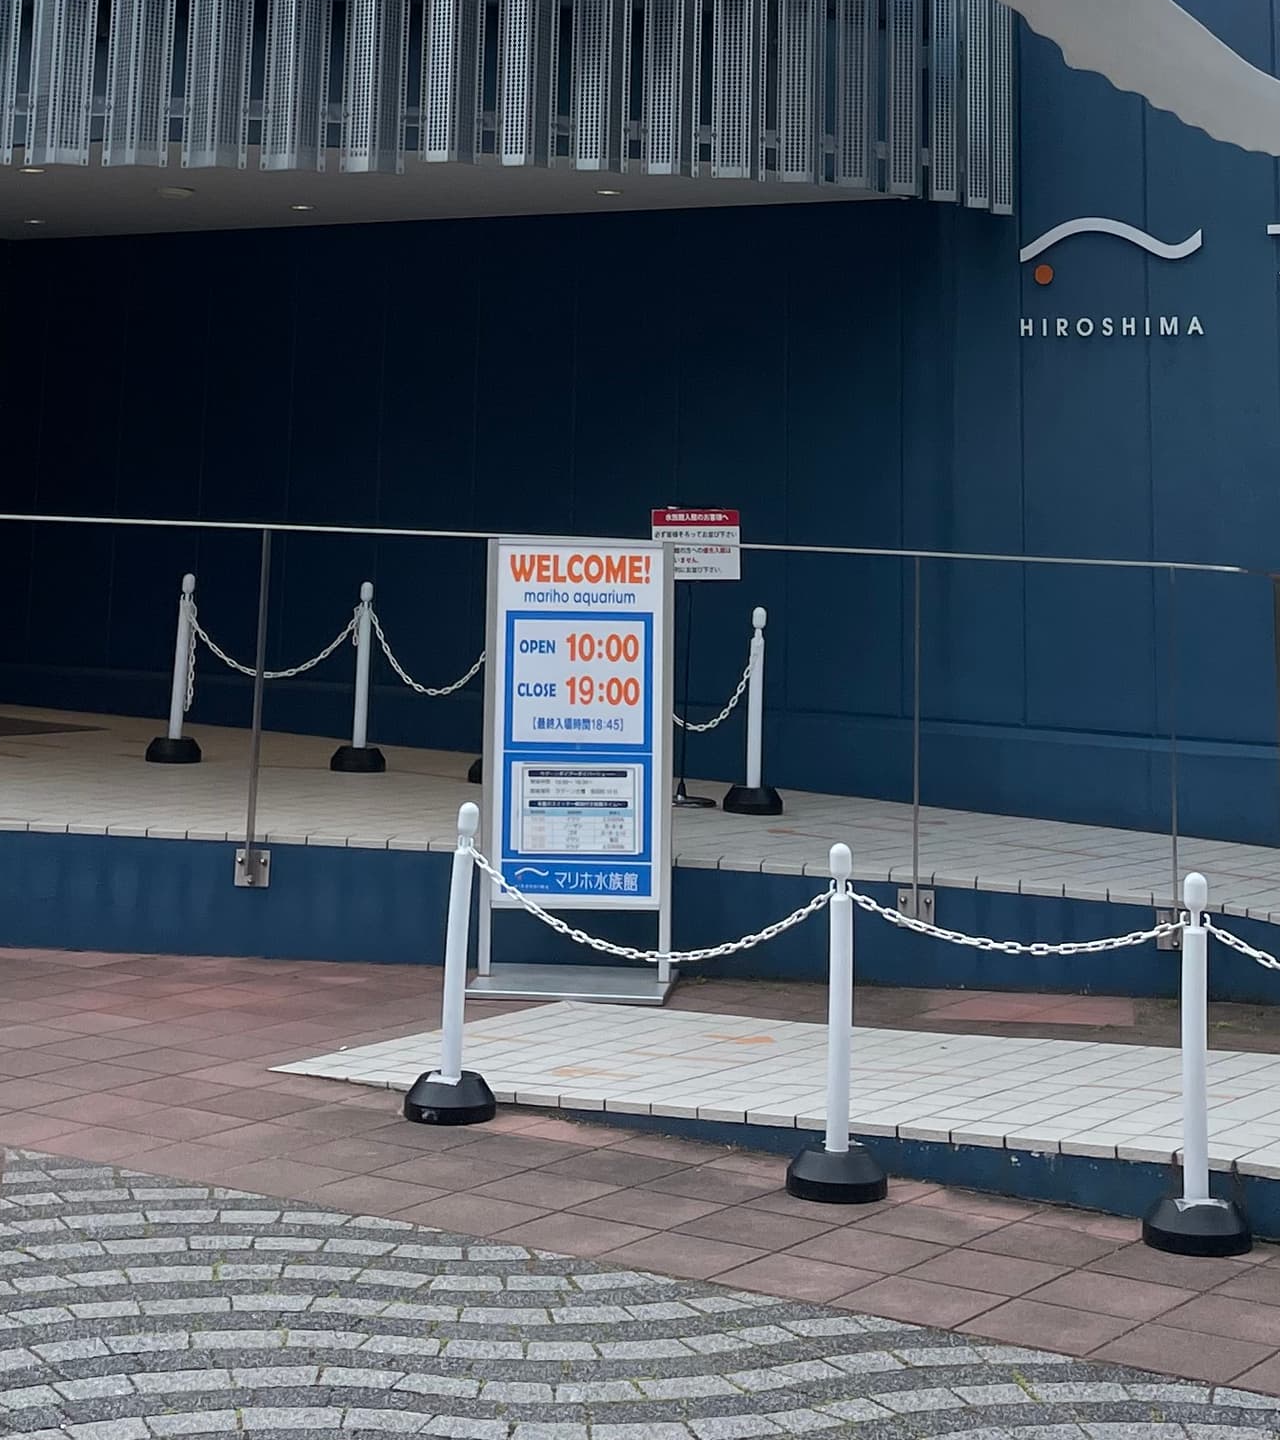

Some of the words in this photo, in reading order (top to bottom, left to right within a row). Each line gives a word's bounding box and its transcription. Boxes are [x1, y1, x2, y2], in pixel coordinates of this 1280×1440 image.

[1020, 316, 1205, 337] HIROSHIMA
[510, 554, 651, 584] WELCOME!
[524, 589, 569, 603] mariho
[573, 590, 636, 607] aquarium
[520, 639, 556, 654] OPEN
[566, 633, 639, 662] 10:00
[517, 683, 557, 697] CLOSE
[565, 676, 640, 706] 19:00
[554, 871, 638, 892] マリホ水族館
